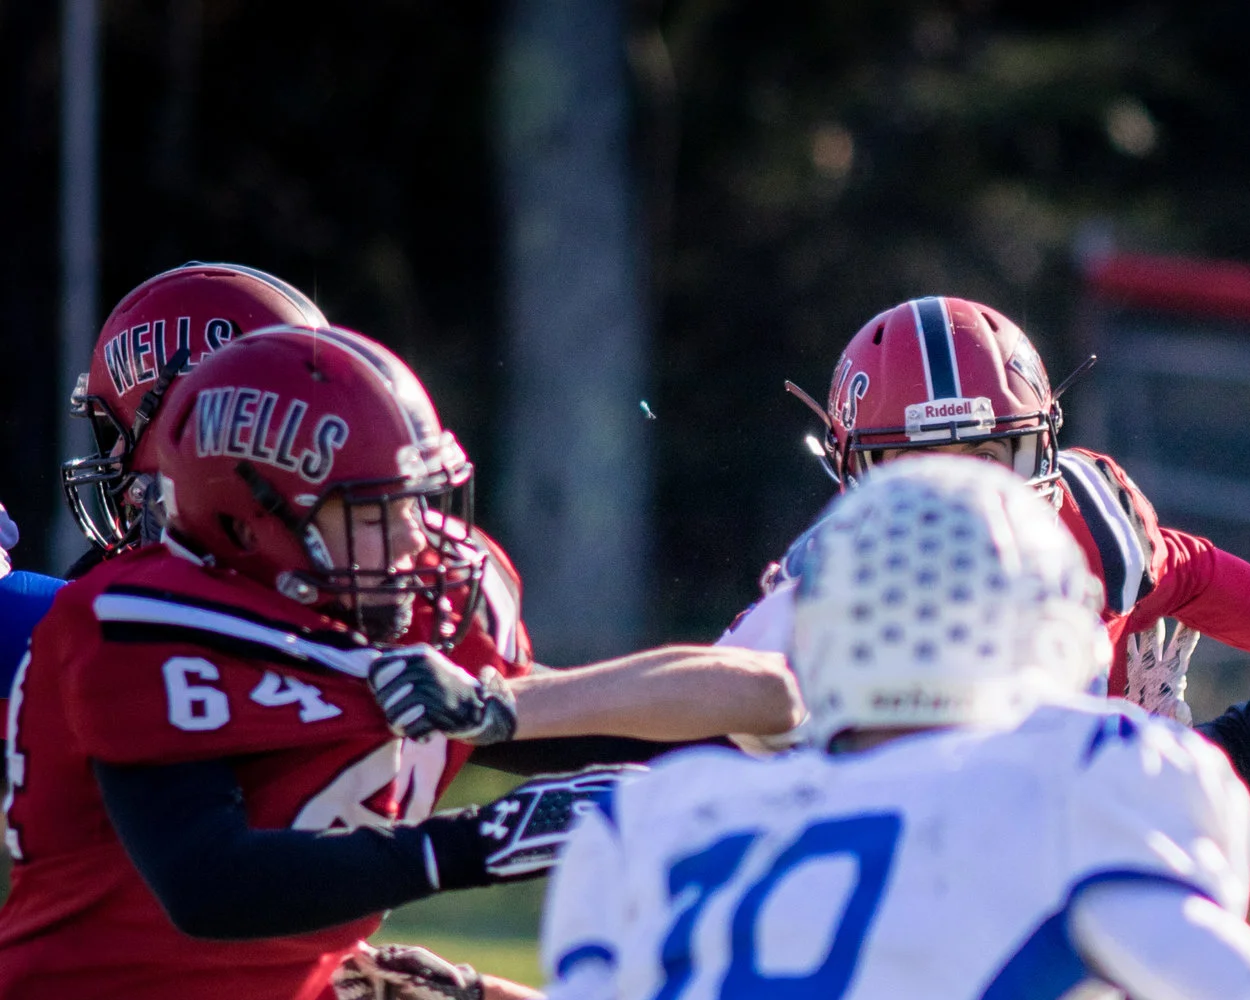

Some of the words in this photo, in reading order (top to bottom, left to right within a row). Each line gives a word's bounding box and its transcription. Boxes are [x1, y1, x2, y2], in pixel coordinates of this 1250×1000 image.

[104, 316, 233, 397] WELLS
[196, 386, 350, 484] WELLS
[925, 402, 972, 418] Riddell
[161, 656, 342, 732] 64
